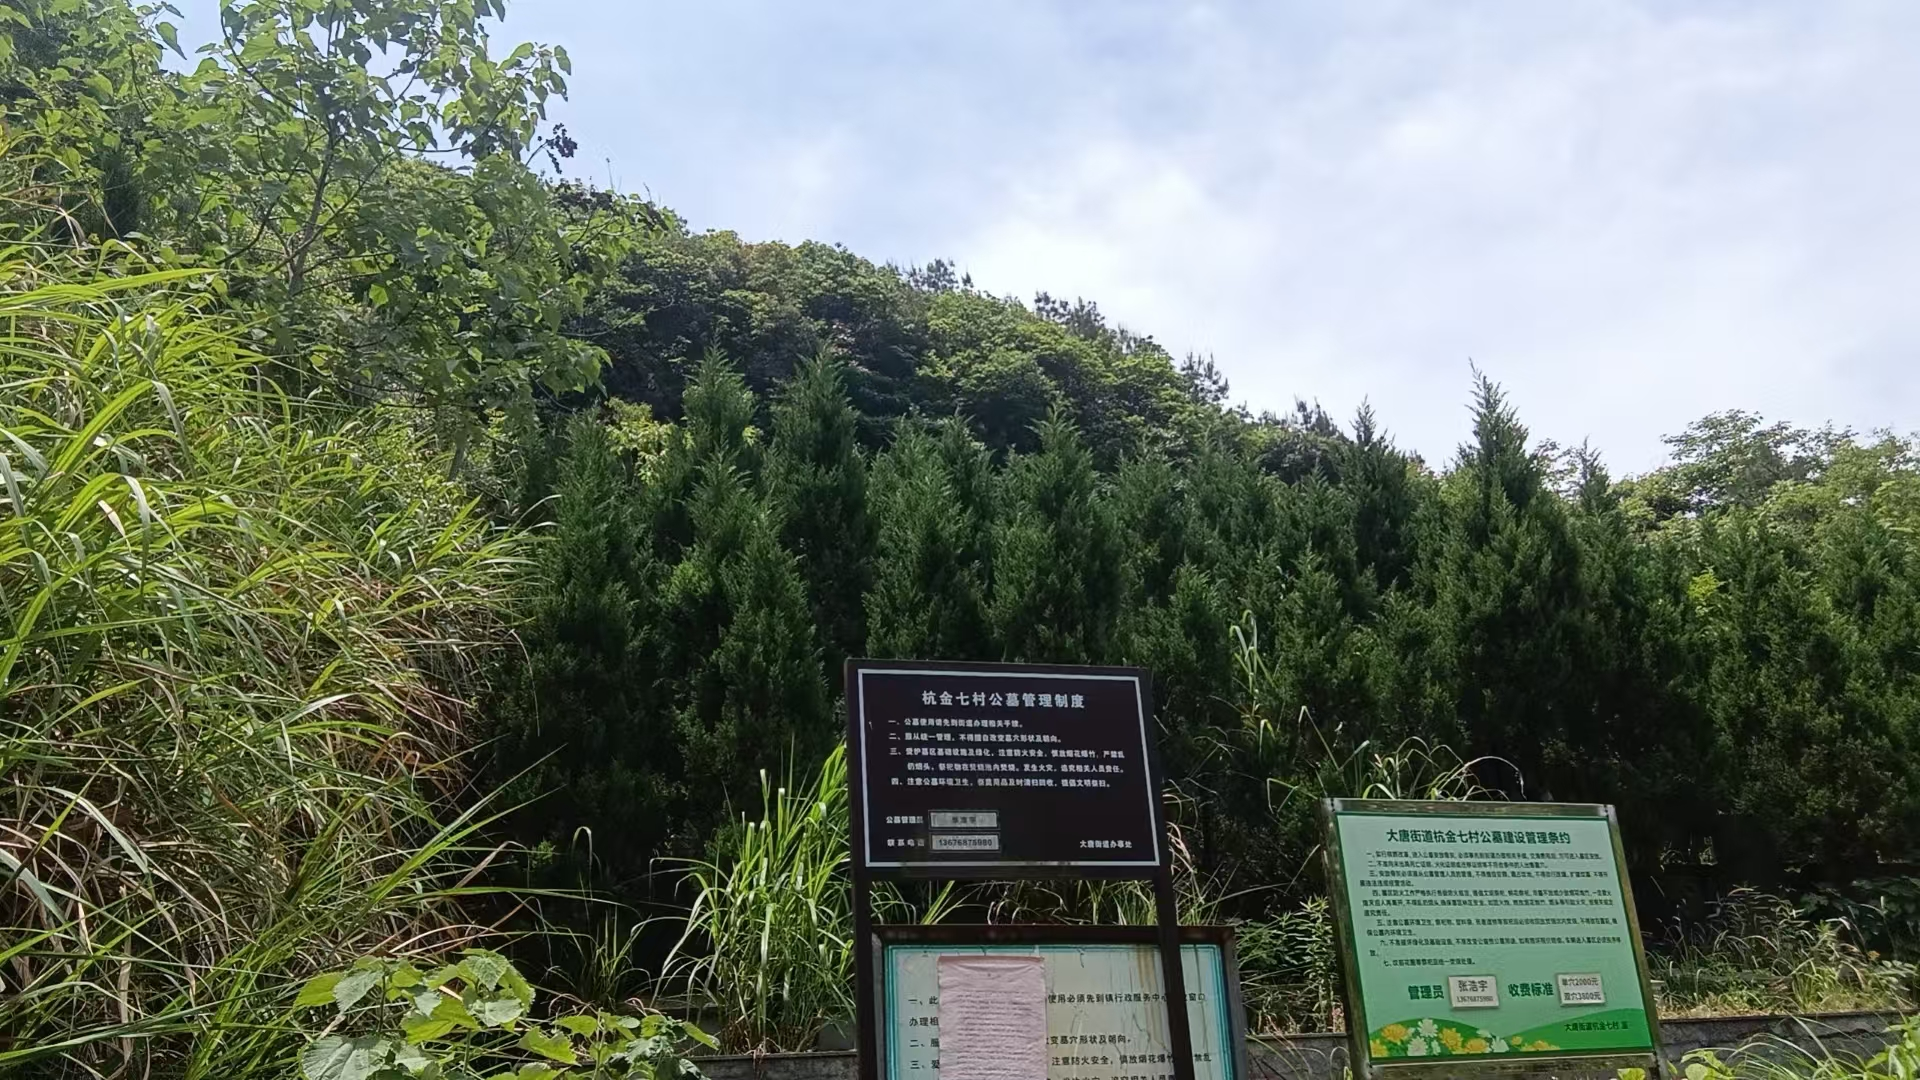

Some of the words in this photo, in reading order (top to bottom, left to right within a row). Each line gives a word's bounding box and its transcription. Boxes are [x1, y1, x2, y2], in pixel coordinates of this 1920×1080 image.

[922, 690, 1085, 708] 杭金七村公墓管理制度
[1079, 840, 1132, 849] 大唐街道办事处
[1408, 984, 1444, 1000] 管理员
[1508, 982, 1554, 998] 收费标准
